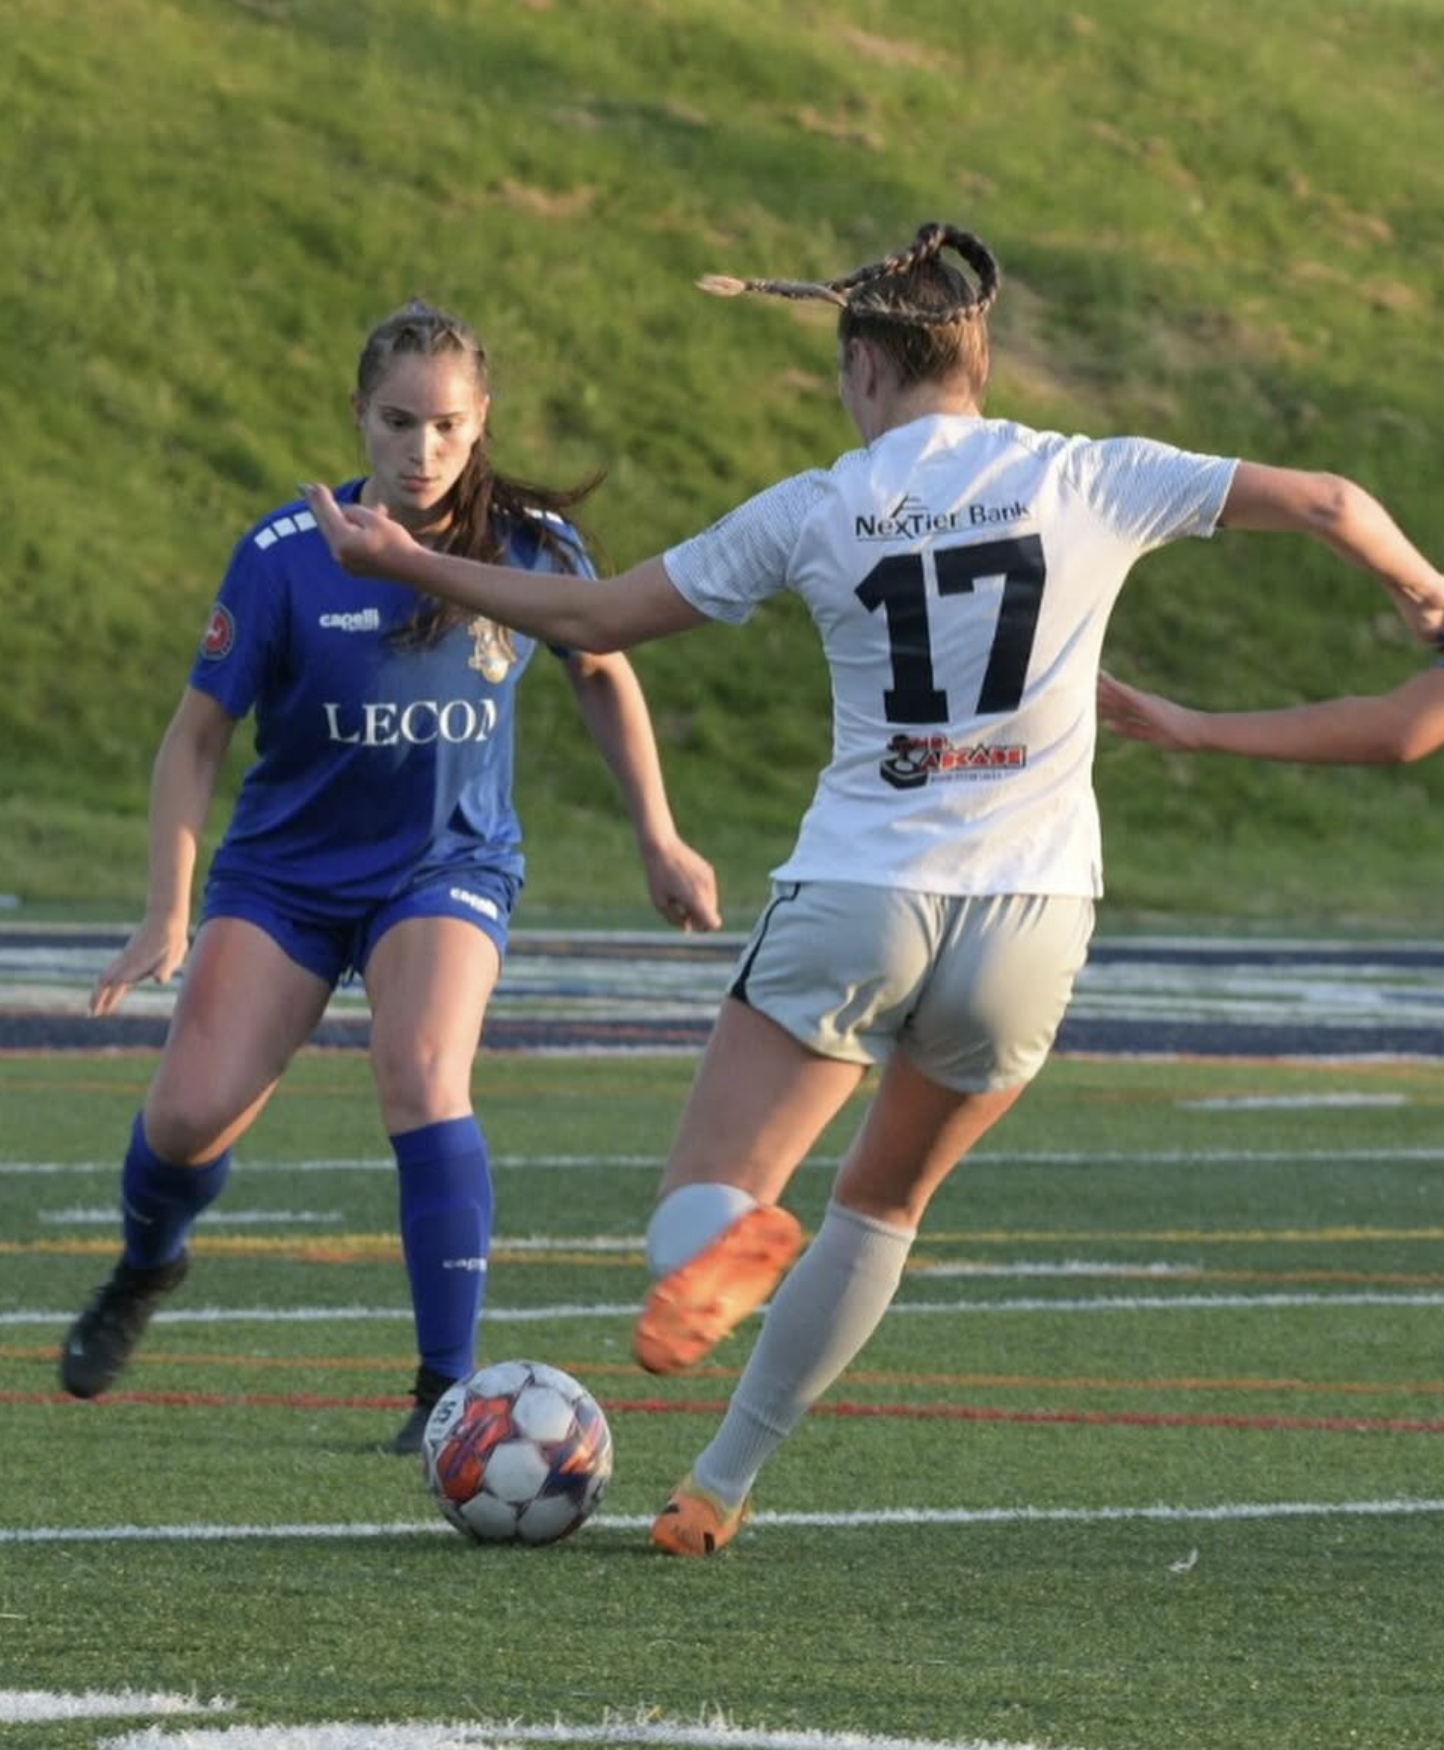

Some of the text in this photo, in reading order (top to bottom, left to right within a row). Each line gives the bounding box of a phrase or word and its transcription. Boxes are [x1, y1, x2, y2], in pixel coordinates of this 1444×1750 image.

[855, 501, 1029, 539] NexTier Bank
[854, 533, 1047, 724] 17
